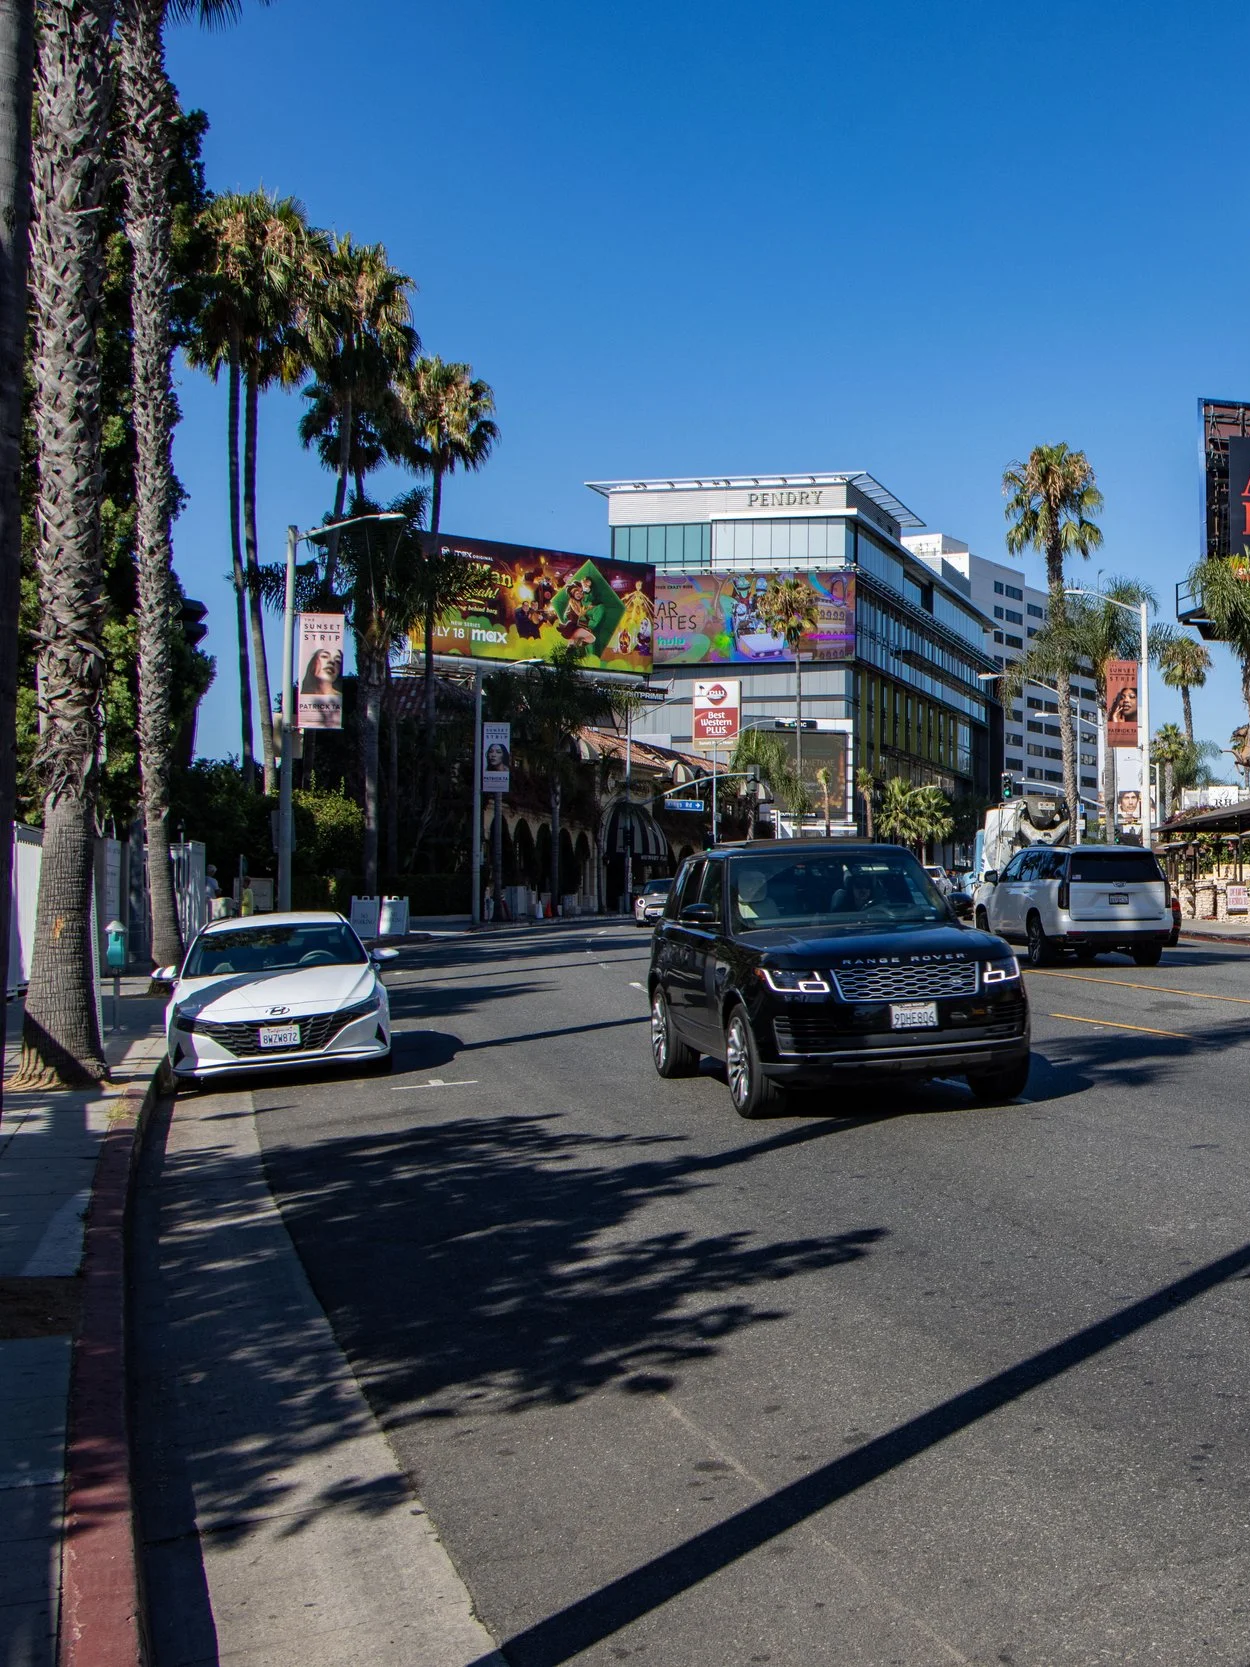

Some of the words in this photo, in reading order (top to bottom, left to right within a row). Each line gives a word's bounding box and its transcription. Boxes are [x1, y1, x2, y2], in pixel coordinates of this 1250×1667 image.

[748, 491, 823, 507] PENDRY
[472, 554, 494, 562] ORIGINAL
[452, 627, 465, 639] 18
[471, 628, 508, 644] max
[657, 636, 686, 645] hulu
[708, 711, 725, 719] Best
[700, 718, 732, 726] Western
[842, 957, 900, 965] RANGE
[910, 953, 965, 962] ROVER
[263, 1032, 298, 1045] 8WZW872
